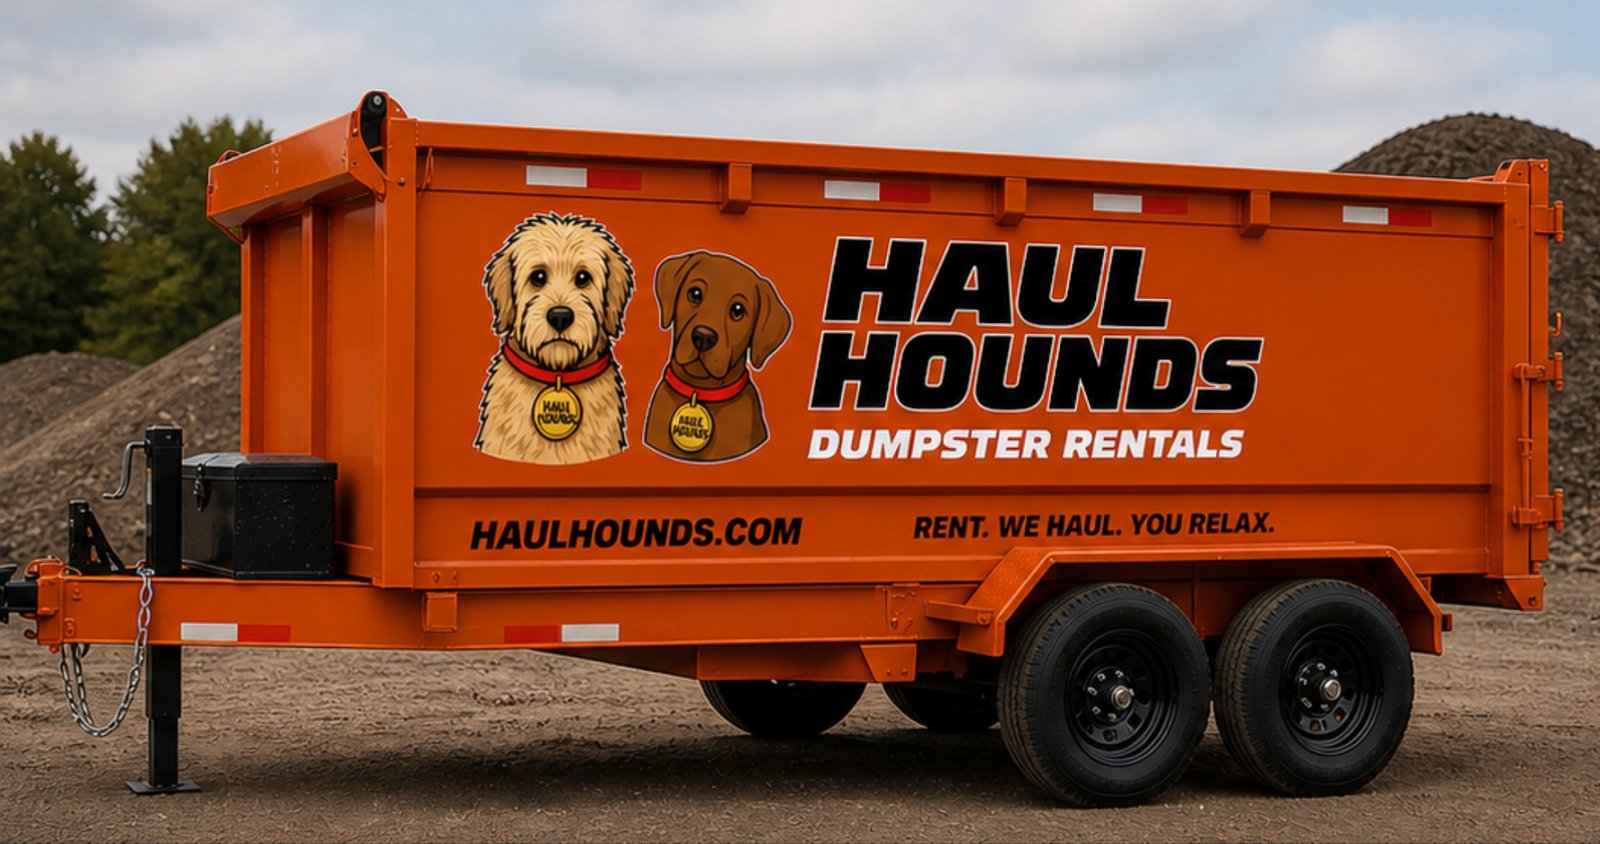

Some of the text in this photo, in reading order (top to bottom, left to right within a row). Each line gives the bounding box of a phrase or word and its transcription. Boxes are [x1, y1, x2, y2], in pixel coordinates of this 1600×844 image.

[822, 236, 1172, 329] HAUL
[807, 331, 1265, 412] HOUNDS
[807, 429, 1245, 460] DUMPSTER RENTALS
[470, 517, 803, 550] HAULHOUNDS.COM
[913, 512, 1274, 539] RENT. WE HAUL. YOU RELAX.
